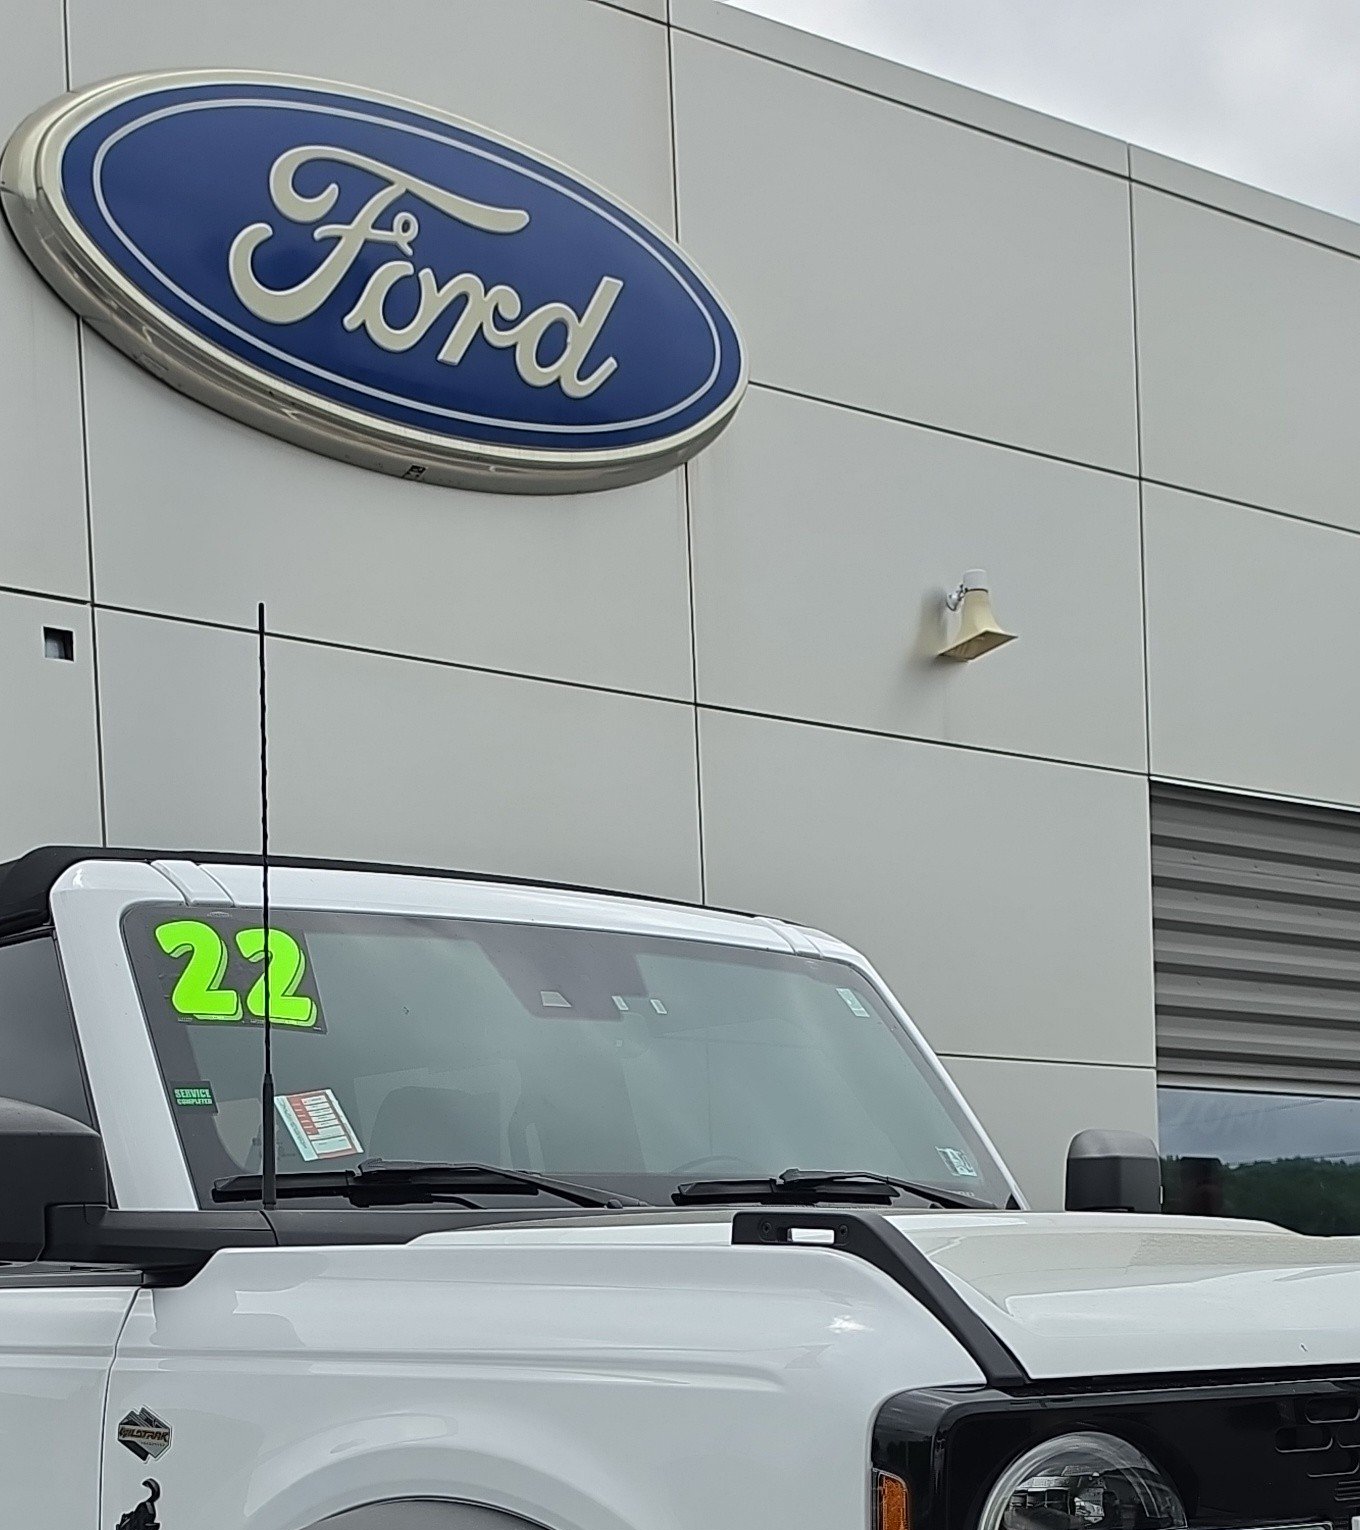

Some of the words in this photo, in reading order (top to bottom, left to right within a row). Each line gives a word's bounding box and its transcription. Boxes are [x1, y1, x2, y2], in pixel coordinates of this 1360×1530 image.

[228, 144, 630, 399] Ford
[154, 920, 317, 1027] 22
[173, 1088, 212, 1099] SERVICE
[119, 1426, 169, 1443] WILDTRAK
